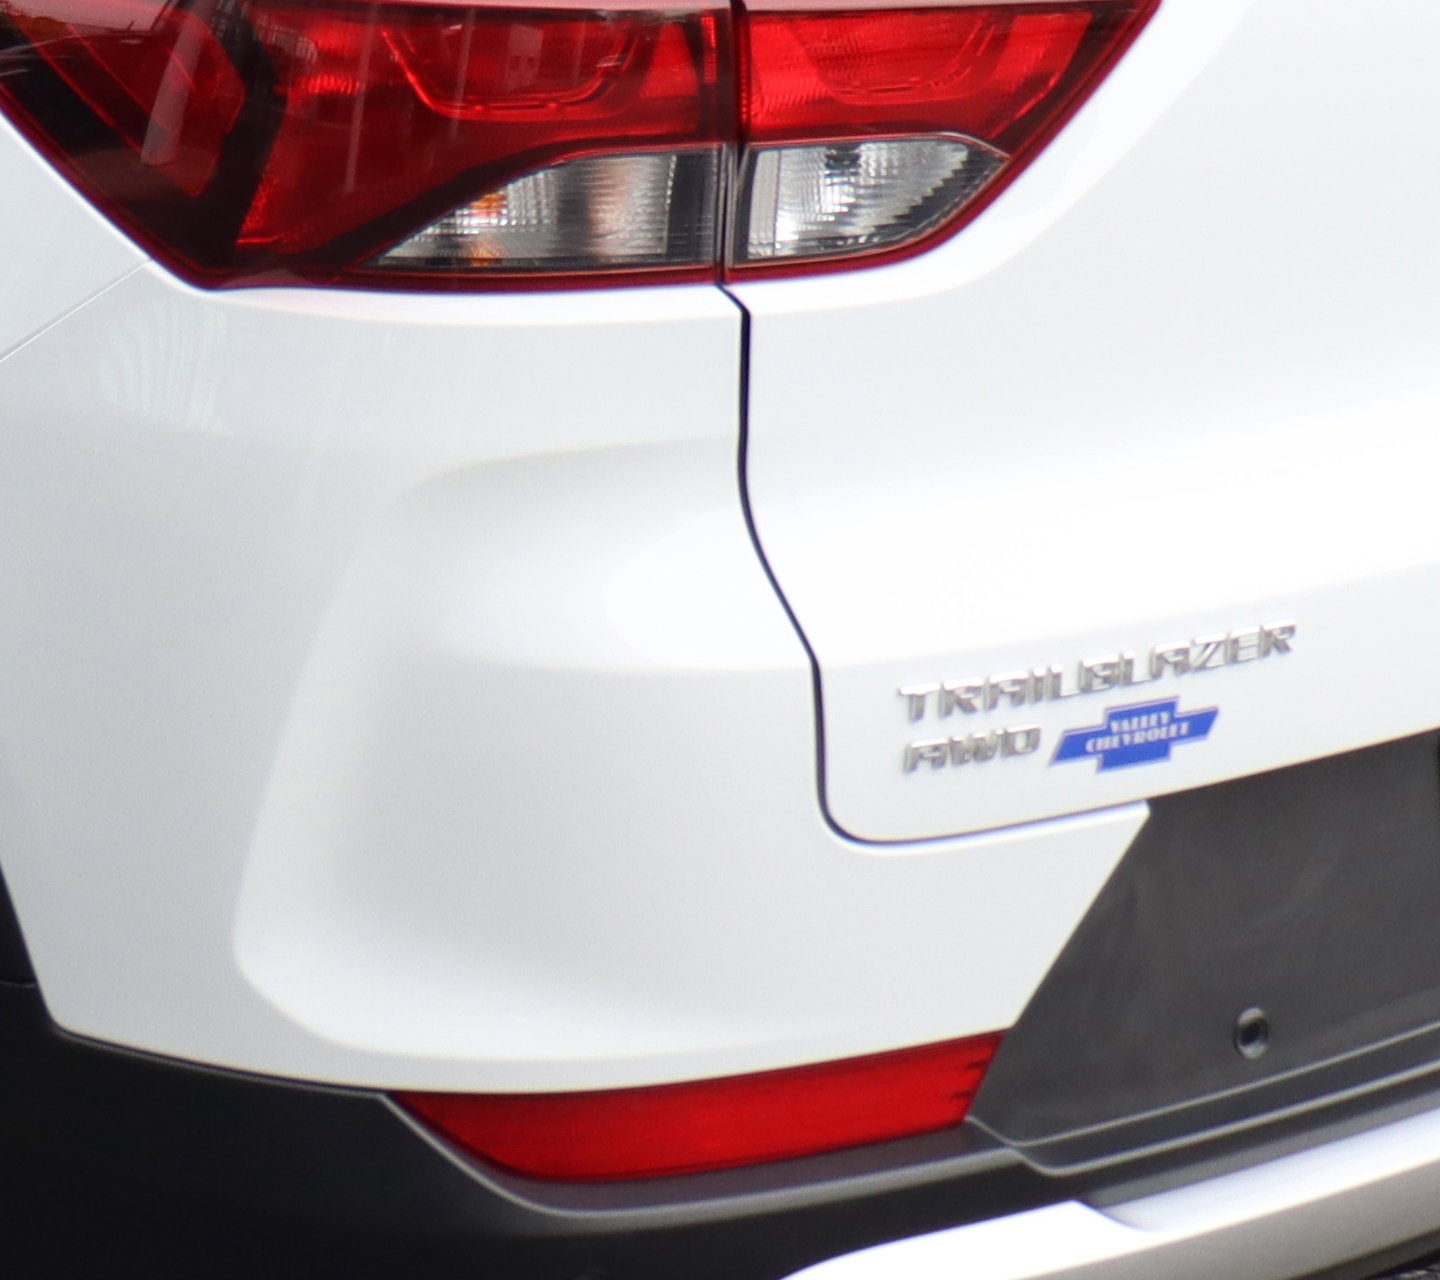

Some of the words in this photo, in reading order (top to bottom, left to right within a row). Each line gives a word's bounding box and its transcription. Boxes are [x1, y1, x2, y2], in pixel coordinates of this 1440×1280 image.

[897, 623, 1296, 722] TRAILBLAZER
[1085, 722, 1191, 753] CHEVROLET
[1110, 711, 1171, 735] VALLEY
[903, 724, 1041, 774] AWD
